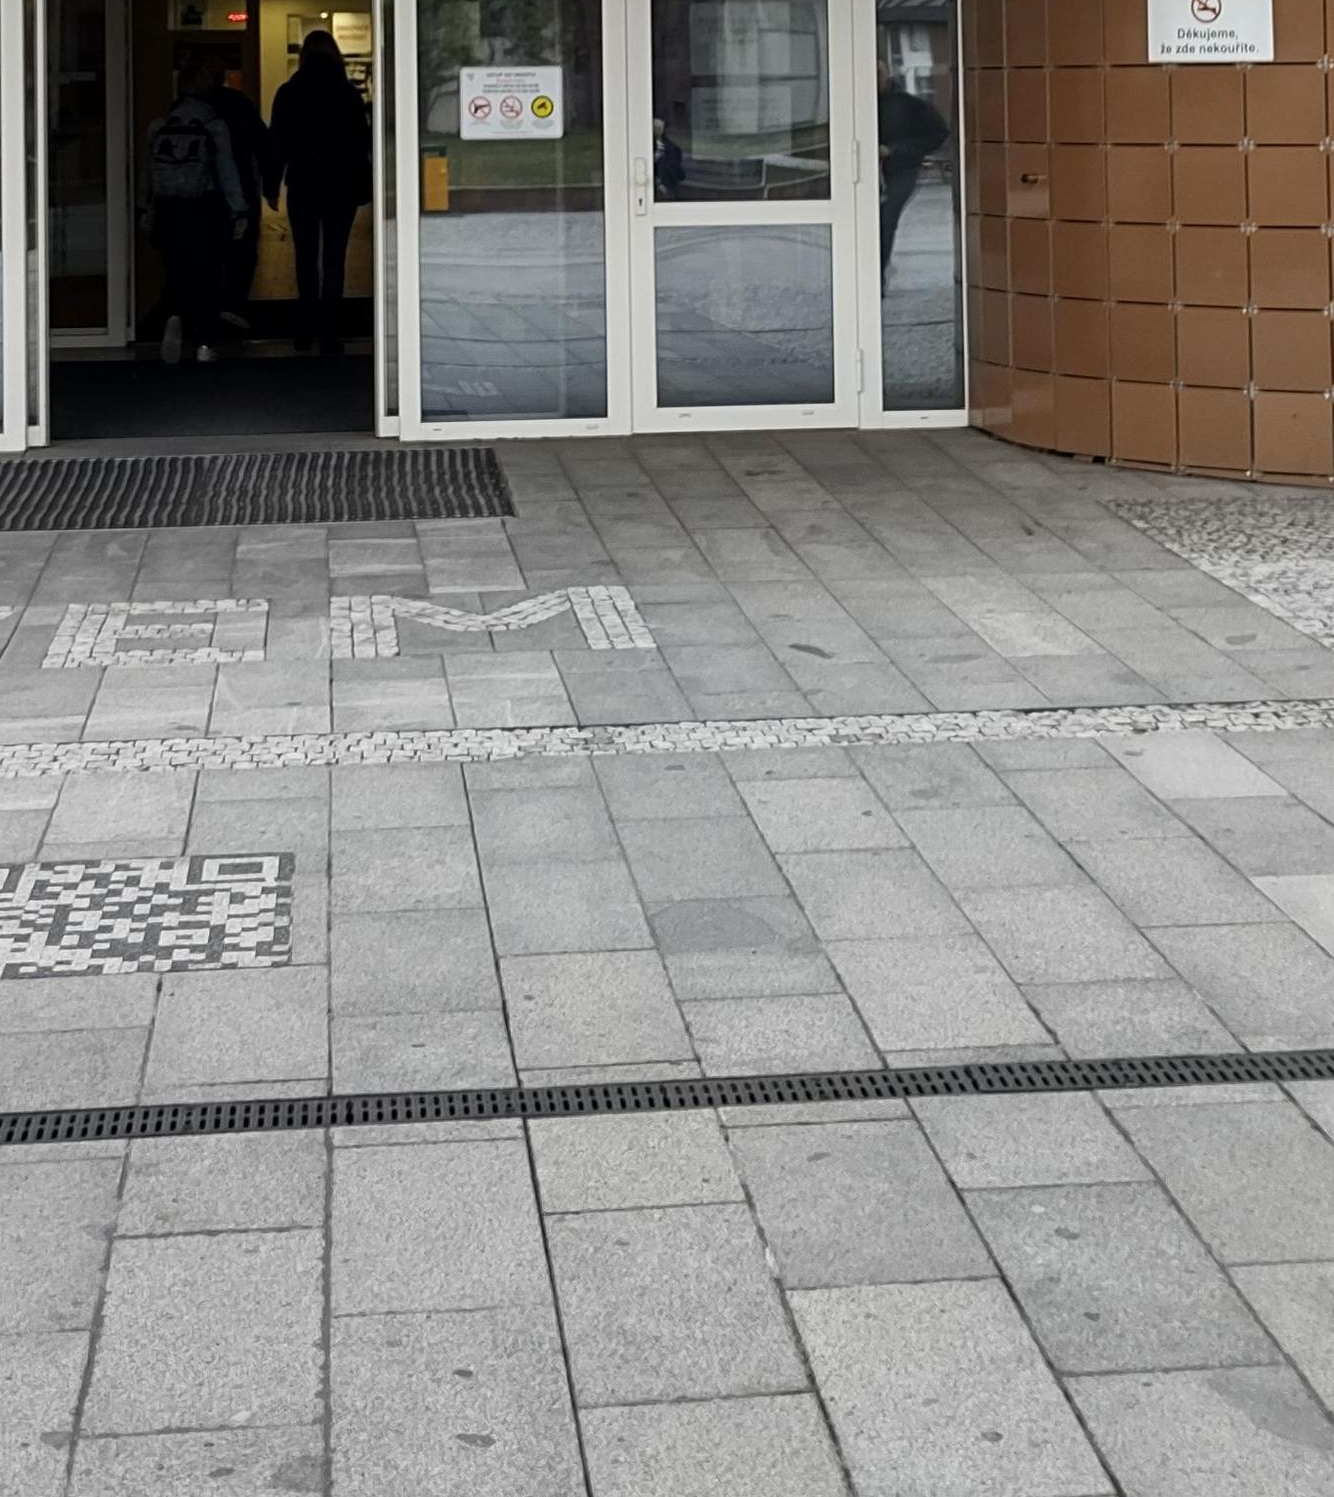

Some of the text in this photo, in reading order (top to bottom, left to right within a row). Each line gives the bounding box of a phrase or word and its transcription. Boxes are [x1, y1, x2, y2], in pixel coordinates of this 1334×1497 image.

[1177, 27, 1239, 41] Děkujeme,
[1160, 43, 1172, 54] že
[1175, 43, 1196, 54] zde
